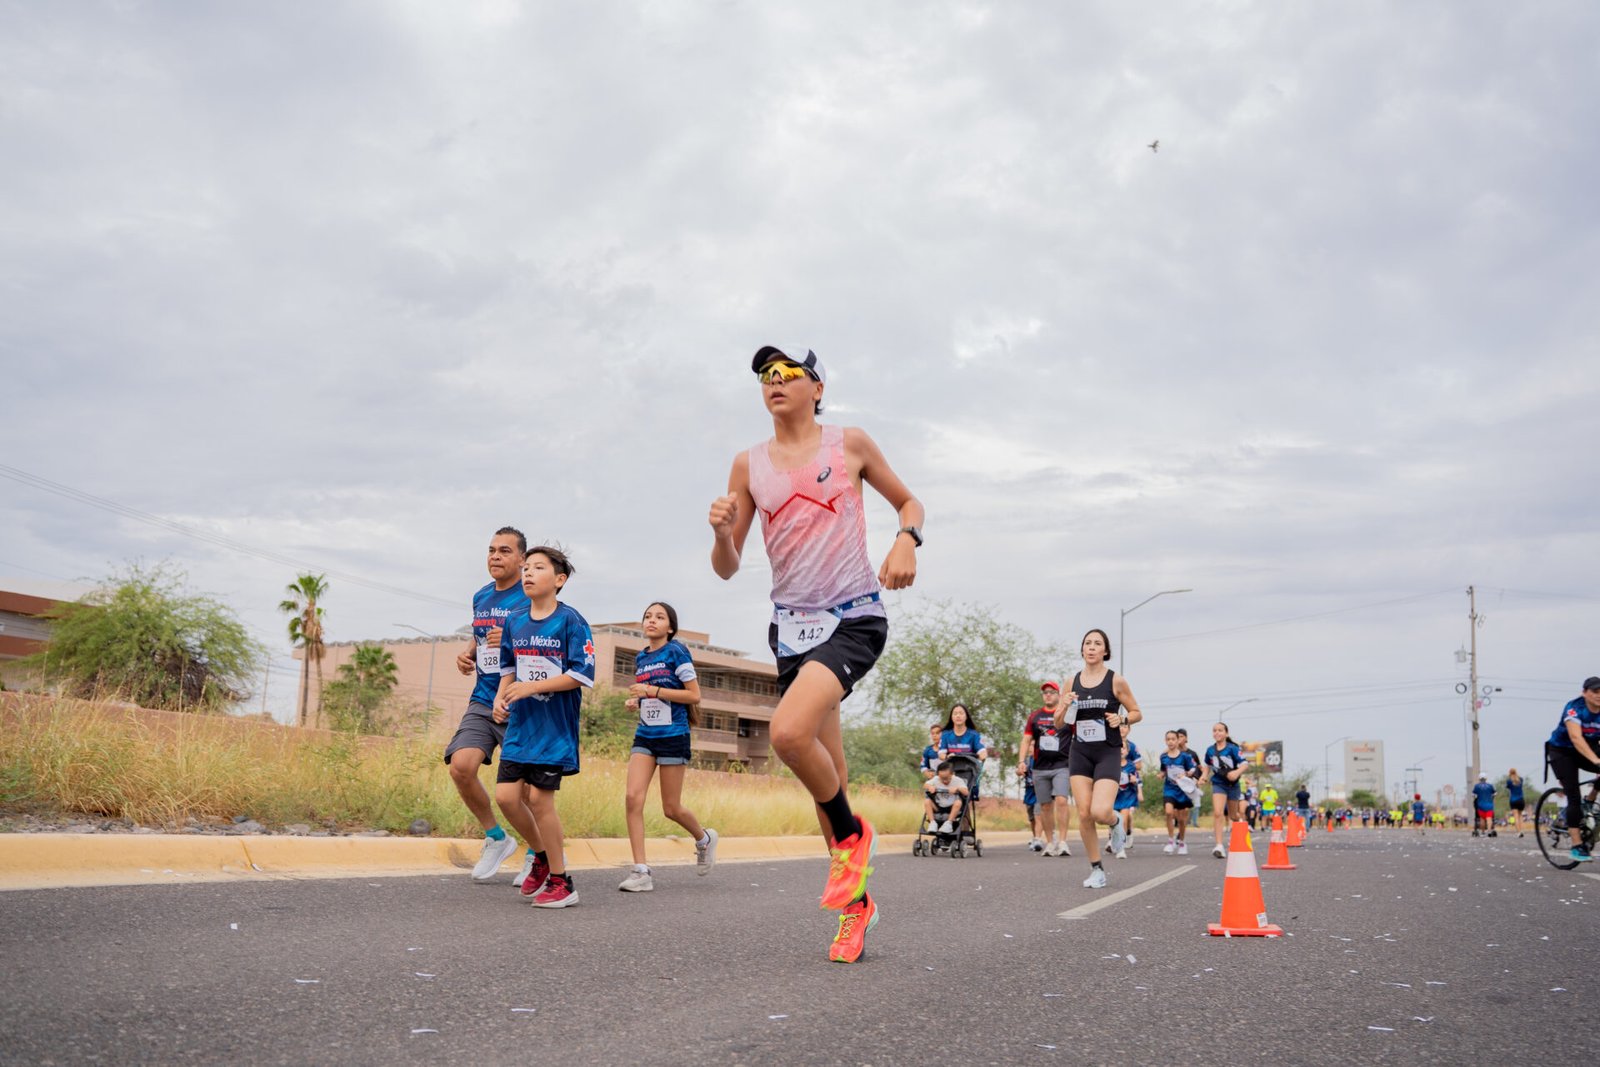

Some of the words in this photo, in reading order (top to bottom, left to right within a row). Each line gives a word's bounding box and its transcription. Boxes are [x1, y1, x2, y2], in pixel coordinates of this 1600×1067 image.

[490, 607, 511, 618] Méxi
[798, 627, 824, 642] 442
[530, 635, 561, 648] México
[483, 656, 499, 667] 328
[528, 670, 548, 682] 329
[646, 709, 661, 719] 327
[1083, 728, 1096, 737] 677
